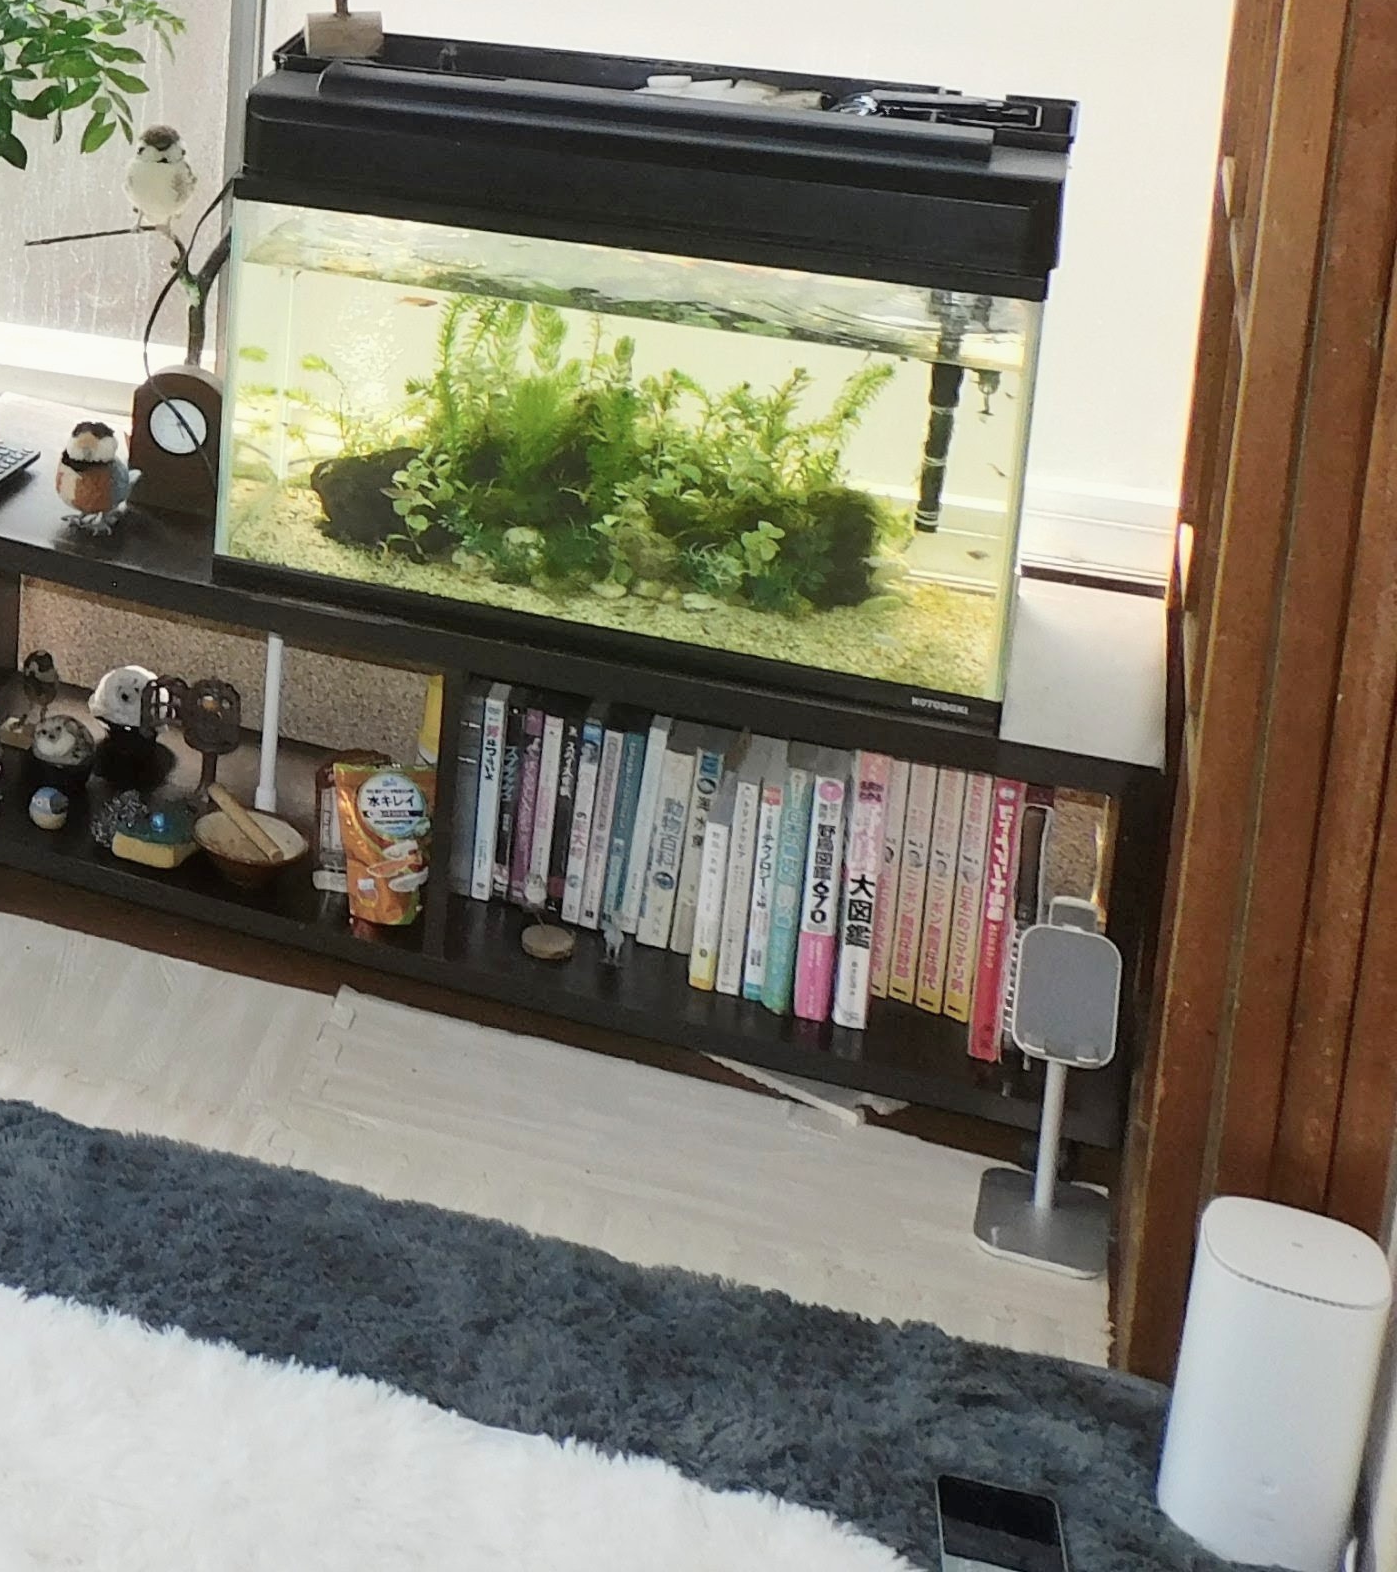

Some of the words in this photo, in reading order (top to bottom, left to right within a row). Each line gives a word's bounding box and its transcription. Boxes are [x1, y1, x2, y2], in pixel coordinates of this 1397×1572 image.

[367, 795, 414, 808] 水キレイ
[845, 874, 876, 950] 大図鑑
